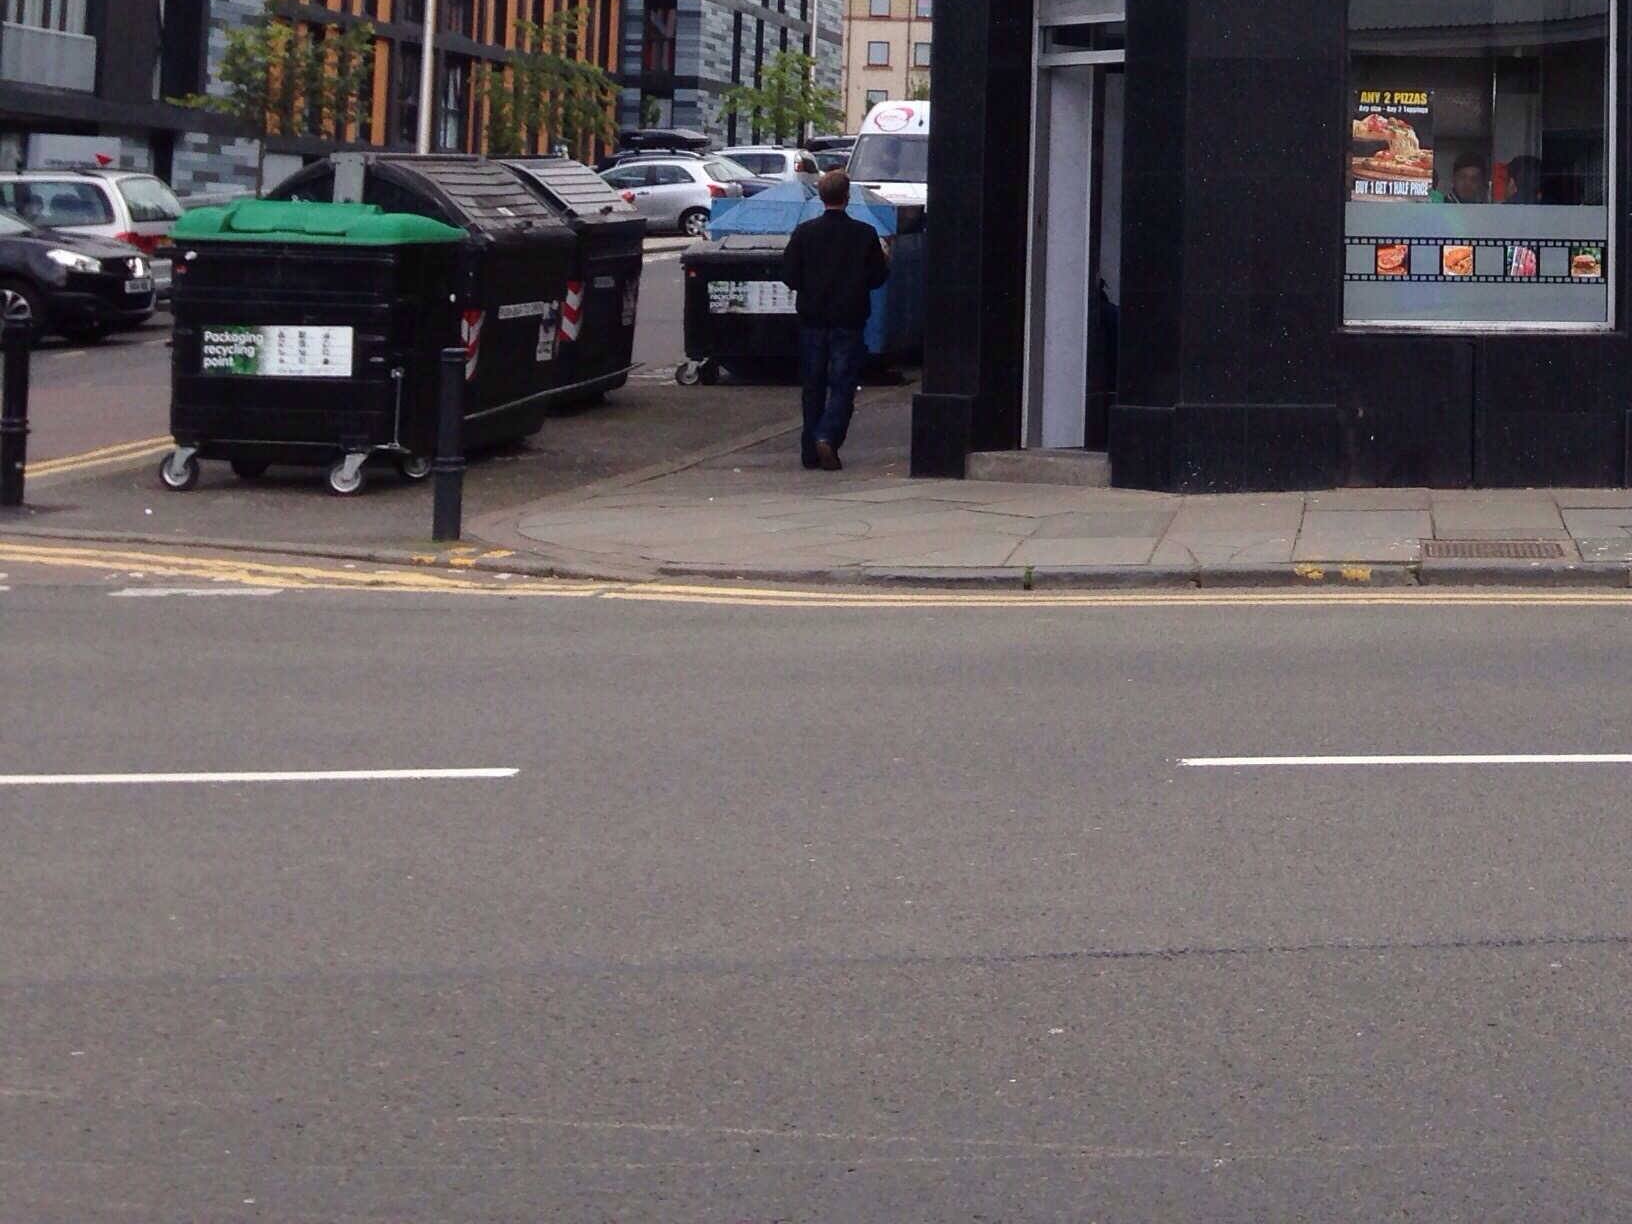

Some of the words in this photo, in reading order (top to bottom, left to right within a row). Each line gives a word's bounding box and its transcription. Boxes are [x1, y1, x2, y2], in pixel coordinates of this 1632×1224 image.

[1360, 91, 1380, 103] ANY
[1383, 91, 1391, 104] 2
[1394, 92, 1428, 105] PIZZAS
[1355, 180, 1368, 194] BUY
[1370, 181, 1374, 194] 1
[1375, 180, 1387, 195] GET
[1388, 182, 1393, 194] 1
[1393, 181, 1409, 195] HALF
[1410, 181, 1429, 196] PRICE
[204, 330, 264, 345] Packaging
[203, 343, 255, 359] recycling
[203, 355, 235, 369] point
